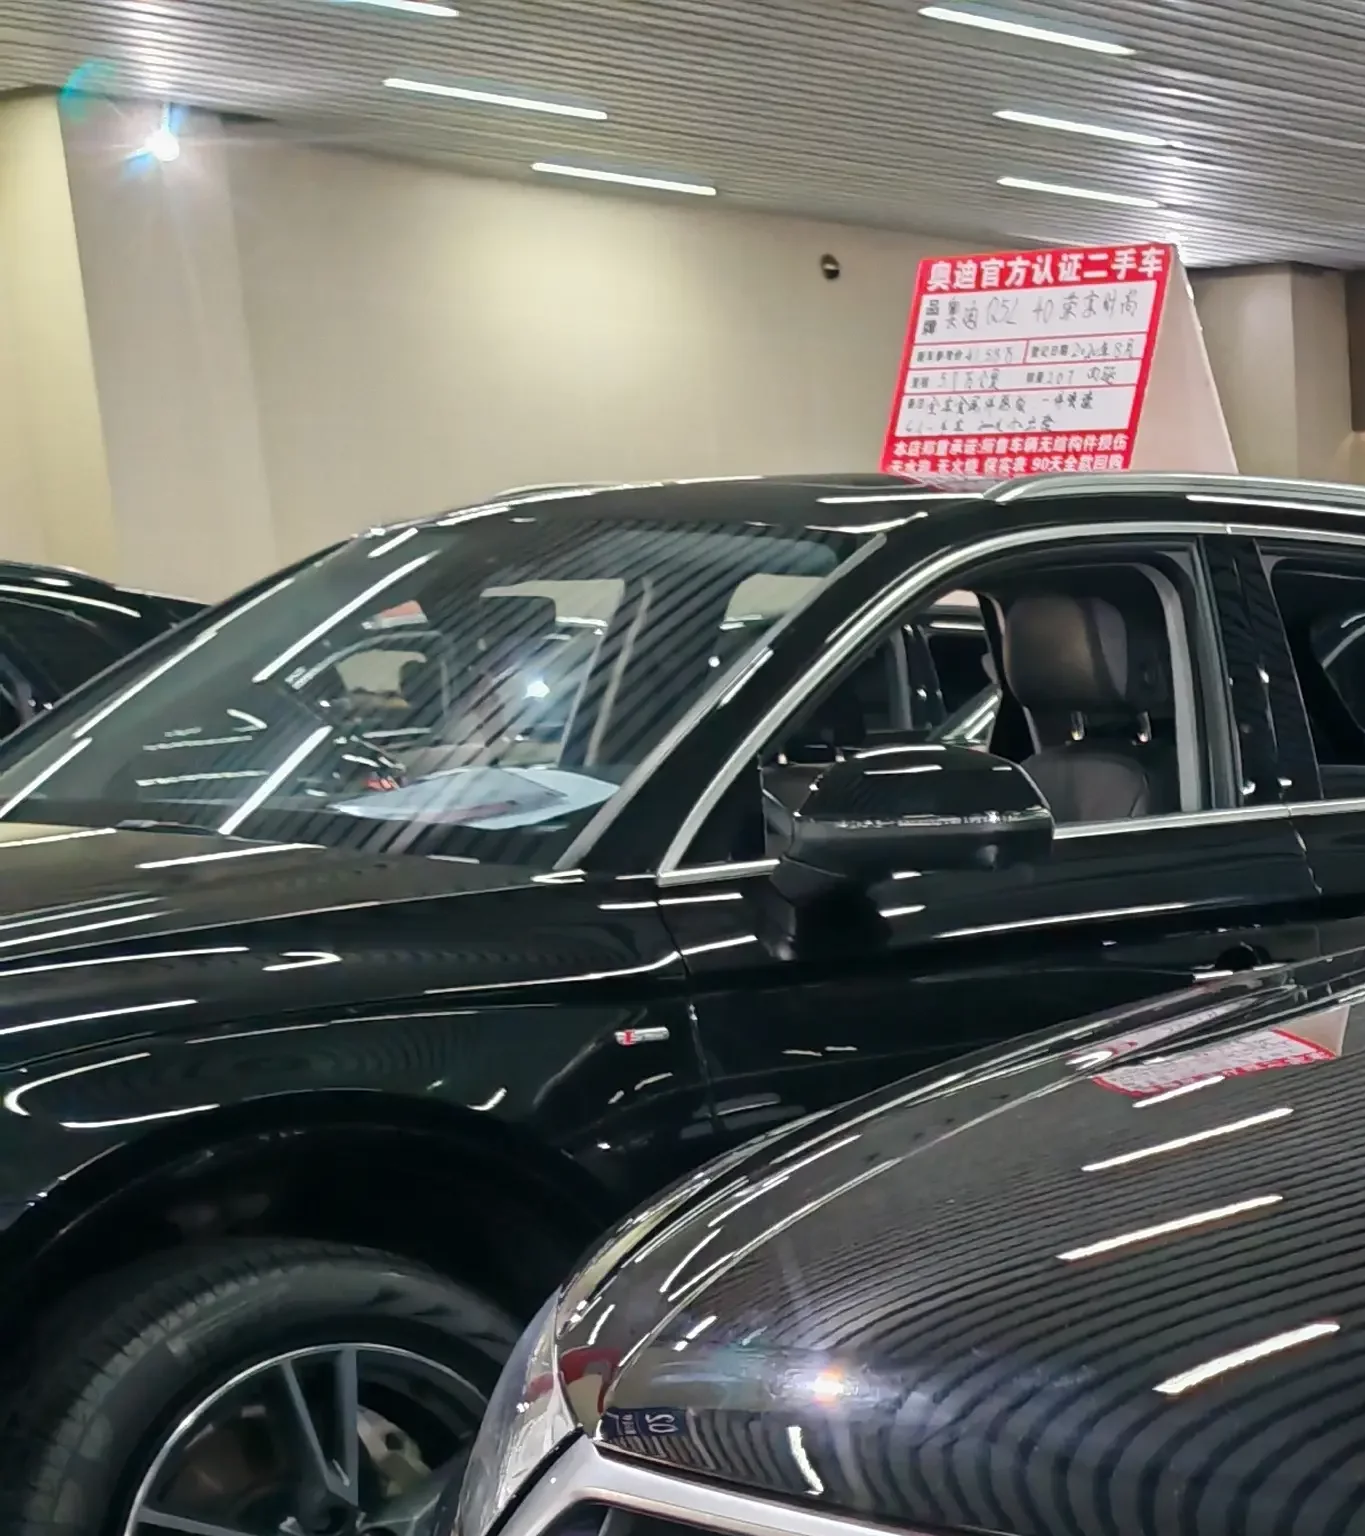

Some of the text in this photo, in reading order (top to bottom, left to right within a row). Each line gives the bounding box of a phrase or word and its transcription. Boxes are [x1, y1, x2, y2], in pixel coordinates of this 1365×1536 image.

[926, 248, 1165, 291] 奥迪官方认证二手车
